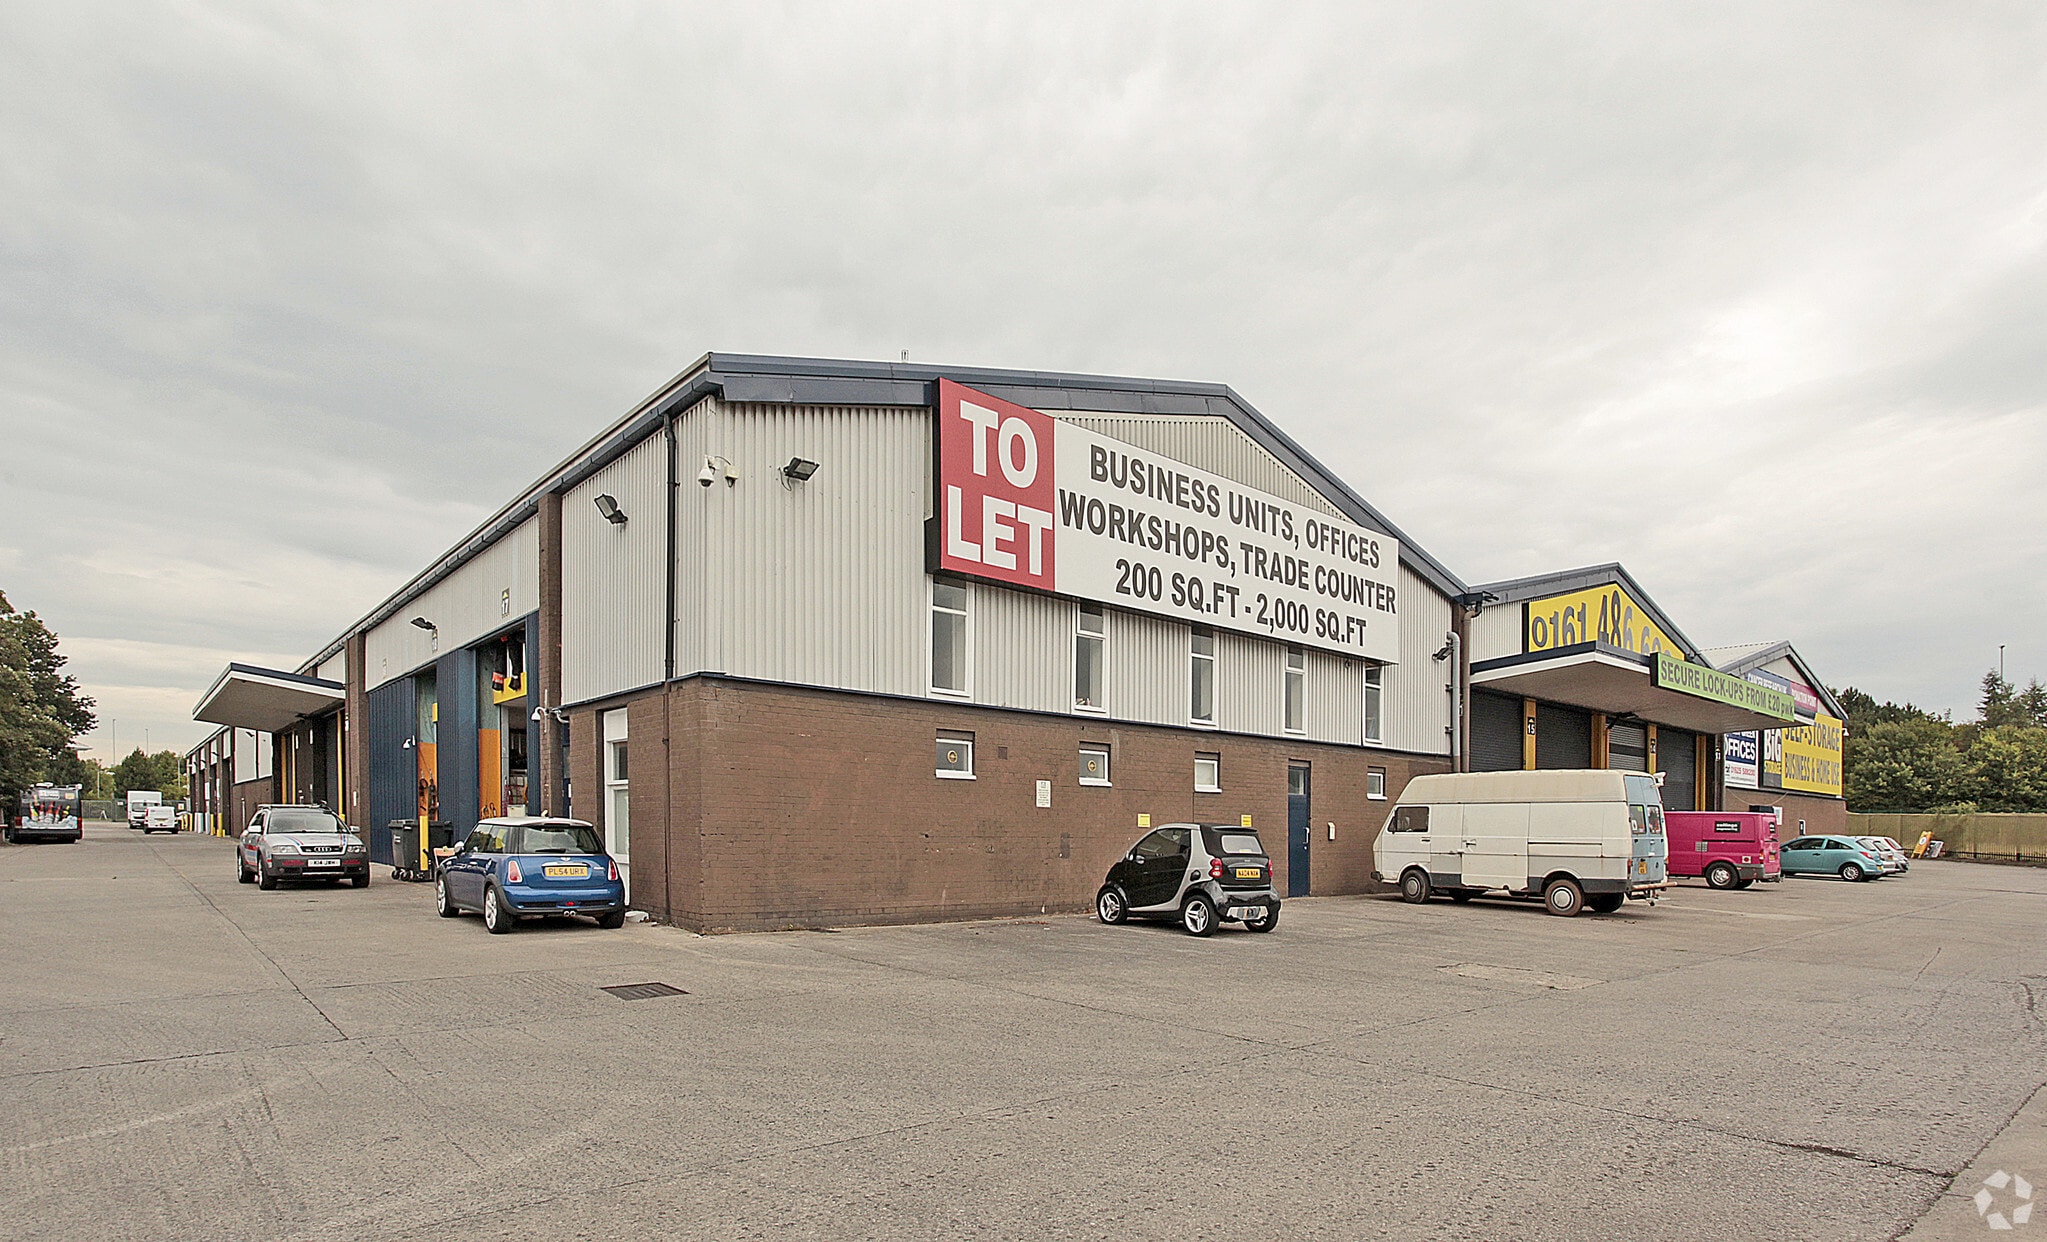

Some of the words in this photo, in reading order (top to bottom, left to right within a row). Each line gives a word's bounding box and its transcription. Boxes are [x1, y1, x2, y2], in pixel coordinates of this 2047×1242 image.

[960, 399, 1038, 489] TO
[947, 484, 1053, 577] LET
[1090, 443, 1221, 518] BUSINESS
[1228, 491, 1299, 551] UNITS,
[1305, 519, 1380, 569] OFFICES
[1058, 488, 1236, 579] WORKSHOPS,
[1240, 542, 1310, 591] TRADE
[1314, 565, 1397, 615] COUNTER
[1115, 558, 1163, 602] 200
[1171, 572, 1240, 619] SQ.FT
[1256, 593, 1309, 634] 2,000
[1315, 608, 1367, 647] SQ.FT
[1531, 601, 1588, 649] 0161
[1597, 590, 1635, 655] 486
[1527, 723, 1535, 735] 15
[1660, 660, 1700, 690] SECURE
[1702, 672, 1744, 702] LOCK-UPS
[1745, 686, 1767, 709] FROM
[1785, 752, 1810, 782] BUSINESS
[1816, 757, 1830, 785] HOME
[1831, 760, 1840, 786] USE
